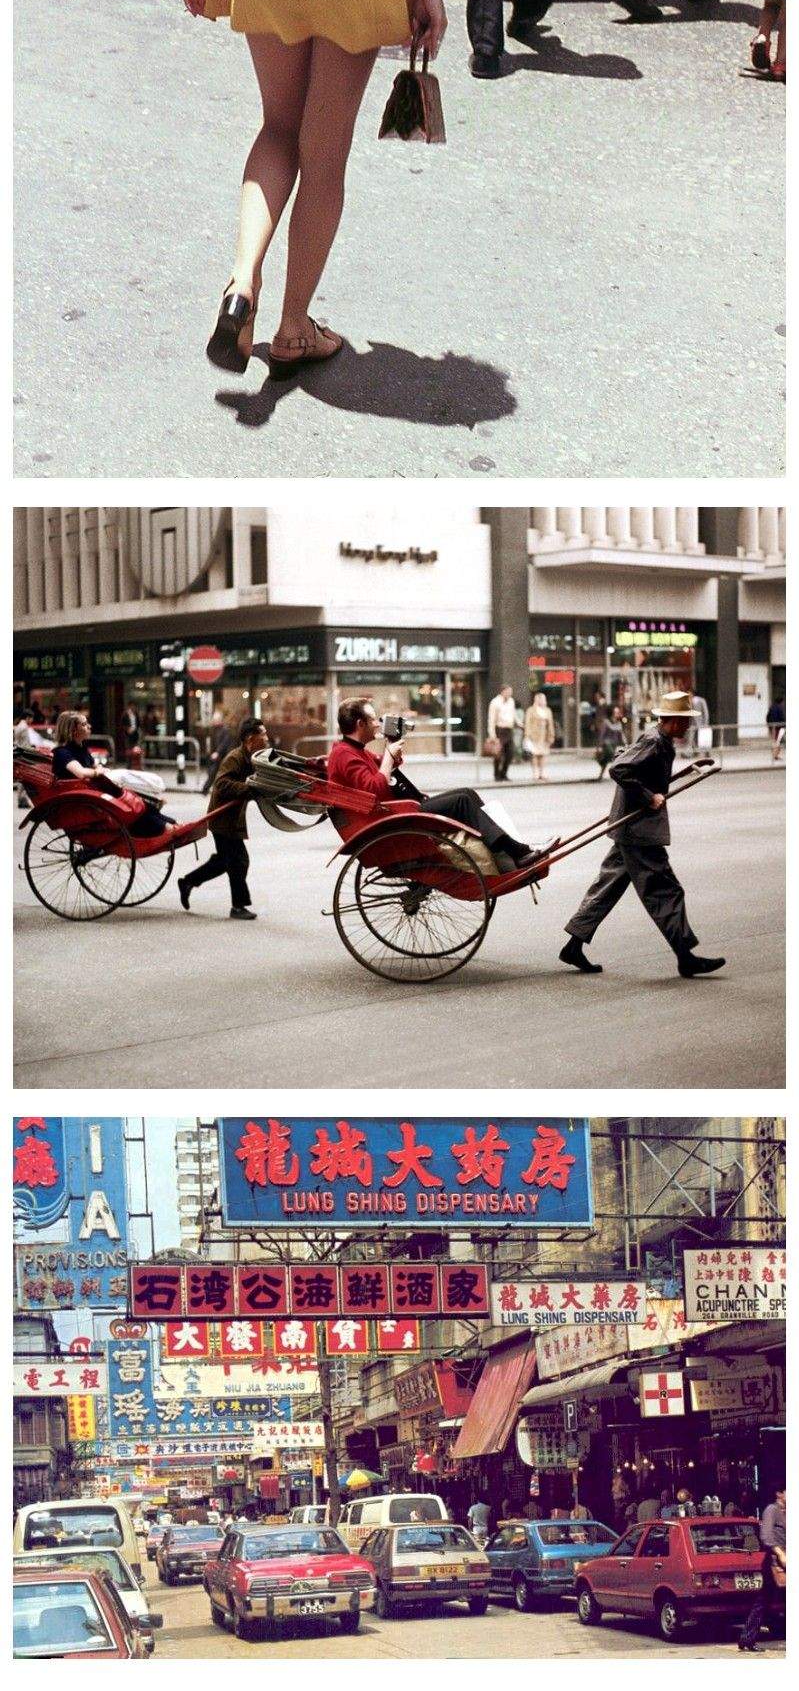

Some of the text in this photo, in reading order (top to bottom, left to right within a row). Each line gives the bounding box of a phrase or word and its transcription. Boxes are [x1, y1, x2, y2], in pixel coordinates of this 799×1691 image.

[334, 637, 398, 663] ZURICH
[281, 1190, 541, 1215] LUNG SHING DISPENSARY
[25, 1250, 128, 1272] PROVISIONS
[696, 1283, 768, 1299] CHAN
[696, 1298, 760, 1312] ACUPUNCTRE
[500, 1311, 530, 1325] LUNG
[534, 1311, 567, 1325] SHING
[573, 1311, 638, 1325] DISPENSARY
[224, 1381, 305, 1393] NIU JIA ZHUANG
